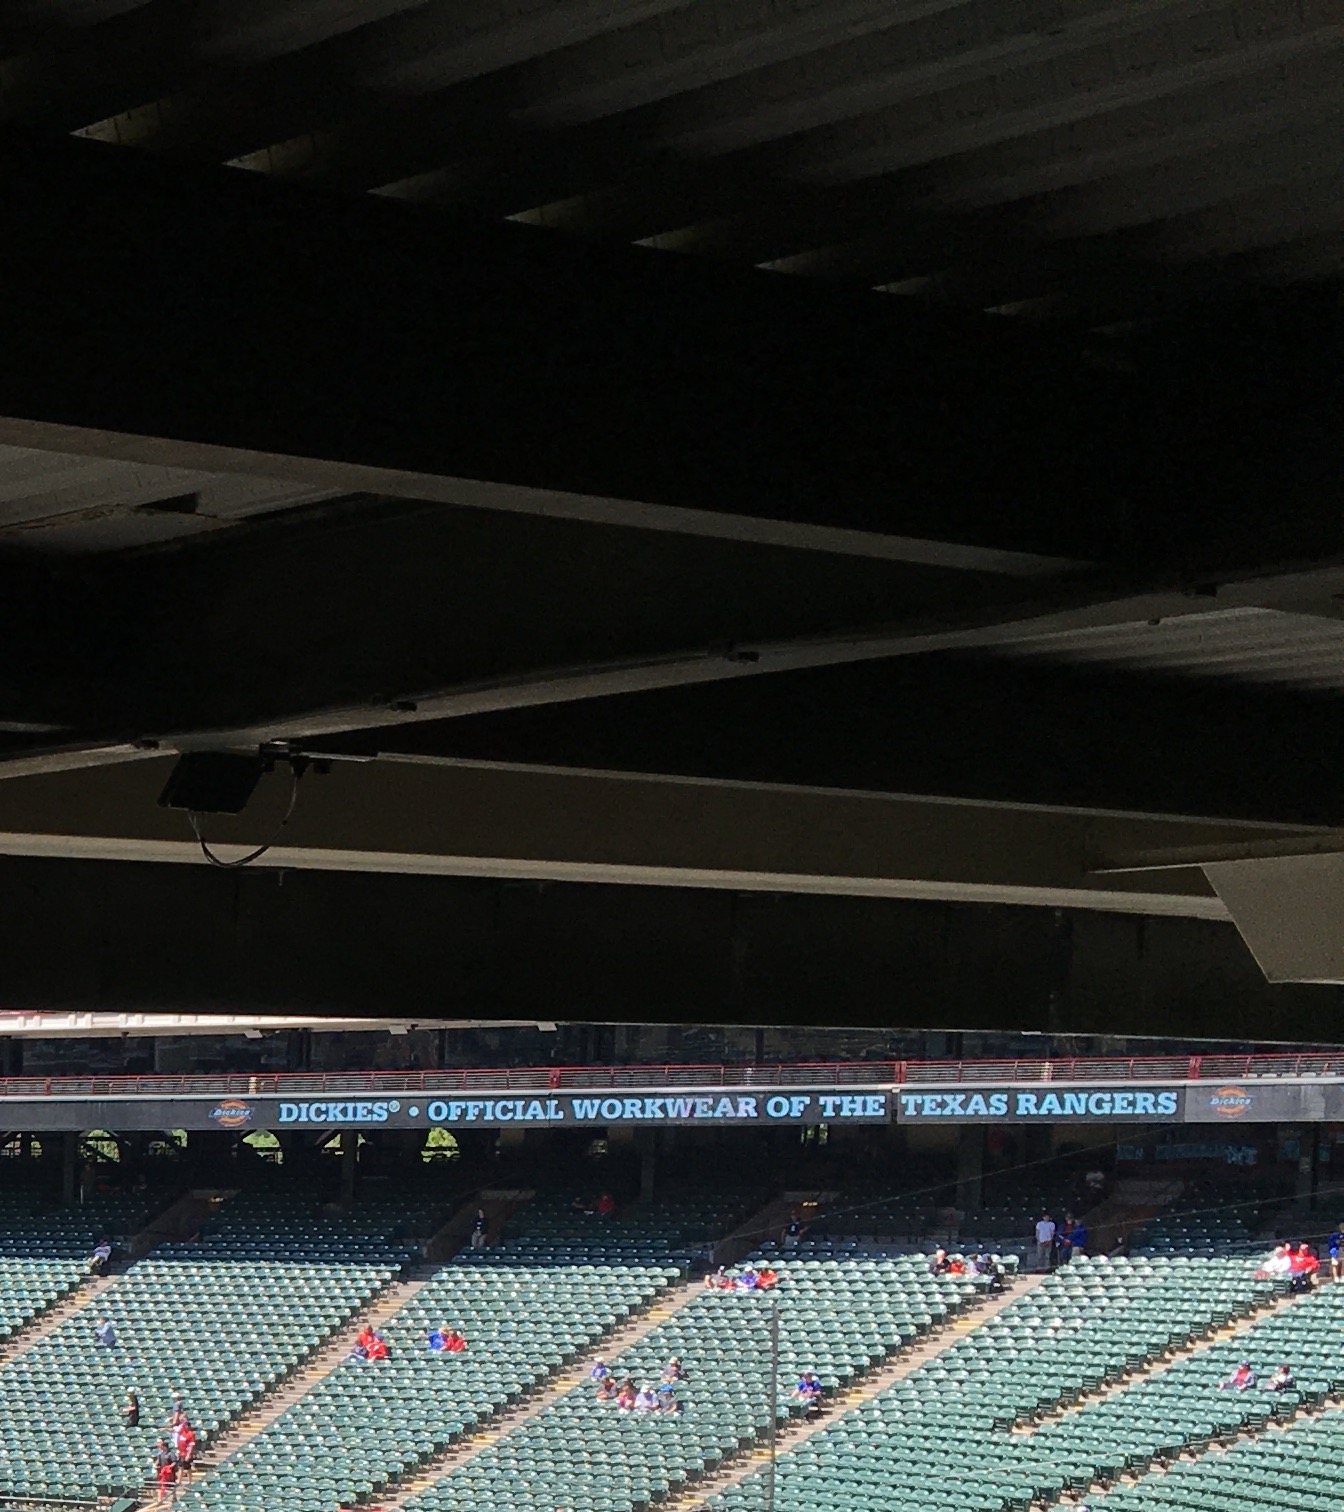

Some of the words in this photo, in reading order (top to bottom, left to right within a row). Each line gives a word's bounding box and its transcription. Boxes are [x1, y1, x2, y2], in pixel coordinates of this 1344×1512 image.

[428, 1100, 564, 1122] OFFICIAL
[571, 1097, 758, 1119] WORKWEAR
[766, 1096, 811, 1118] OF
[819, 1095, 886, 1117] THE
[901, 1093, 1009, 1116] TEXAS
[1016, 1091, 1179, 1116] RANGERS
